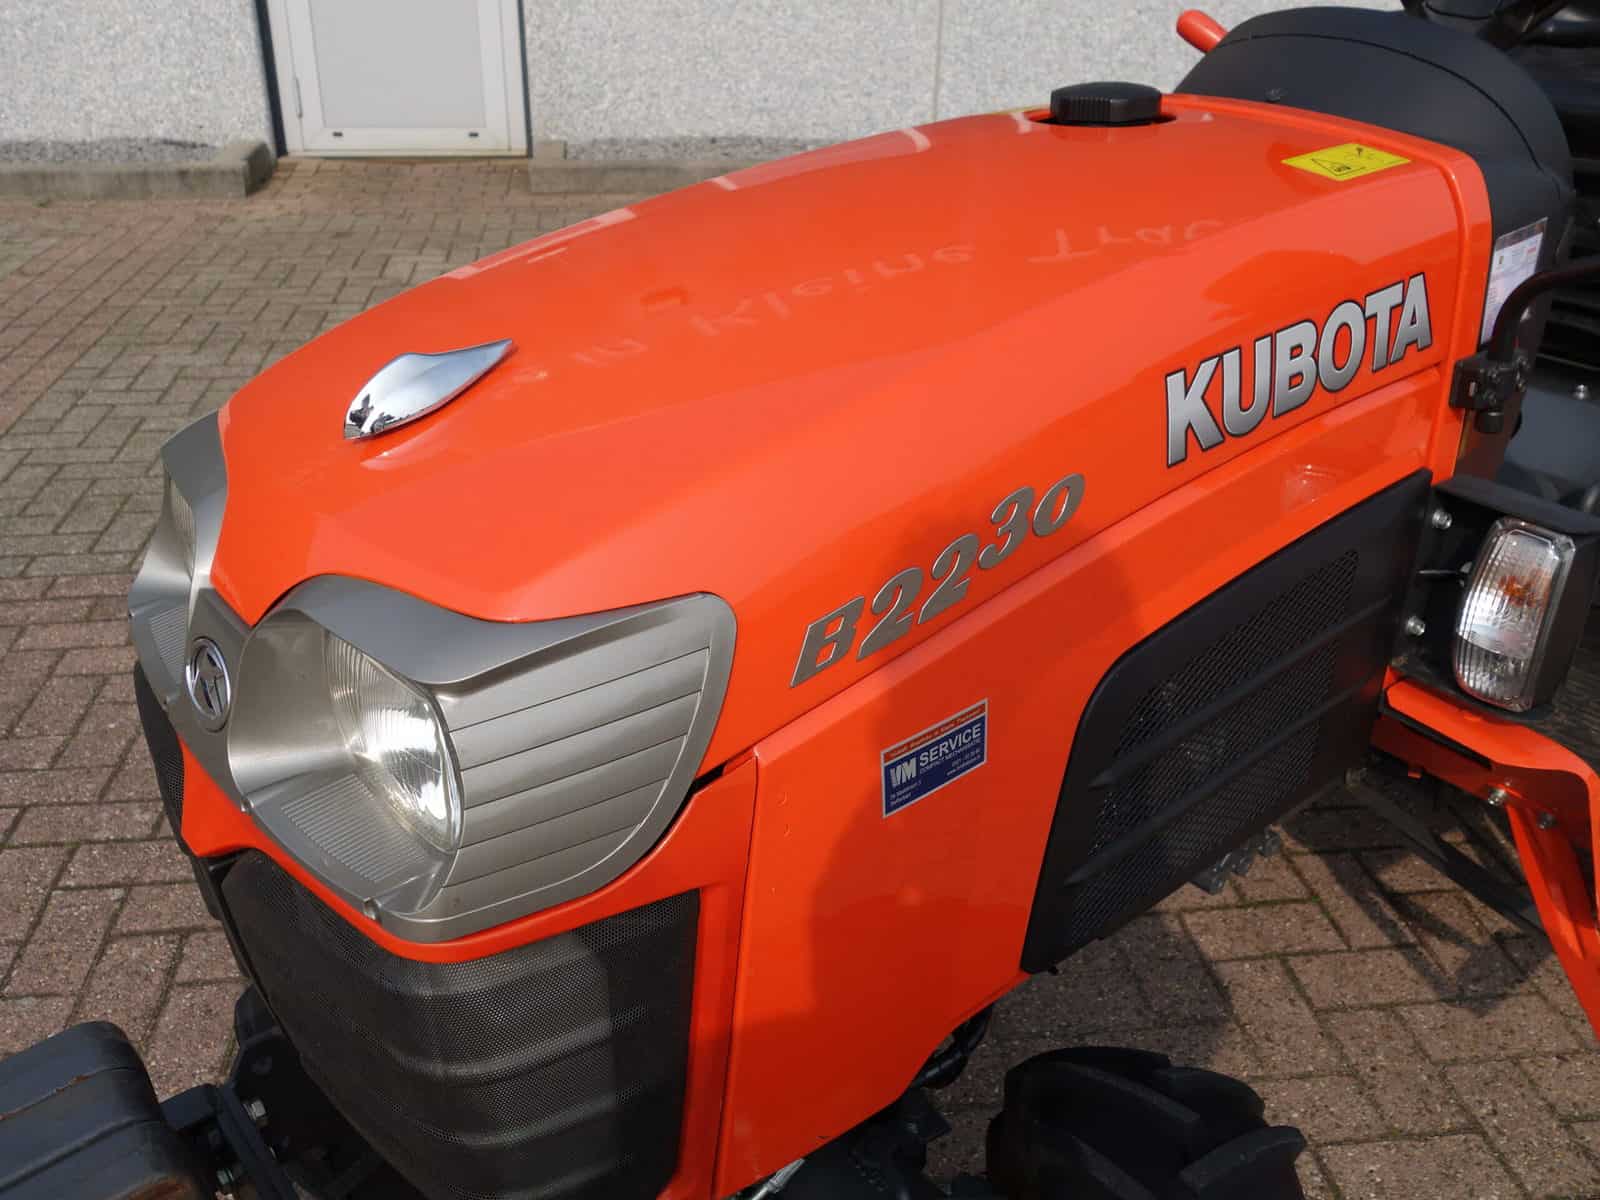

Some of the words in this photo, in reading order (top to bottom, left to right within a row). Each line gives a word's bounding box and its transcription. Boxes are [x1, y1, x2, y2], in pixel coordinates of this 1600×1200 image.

[1165, 272, 1433, 468] KUBOTA
[790, 473, 1086, 688] B2230
[919, 723, 982, 767] SERVICE
